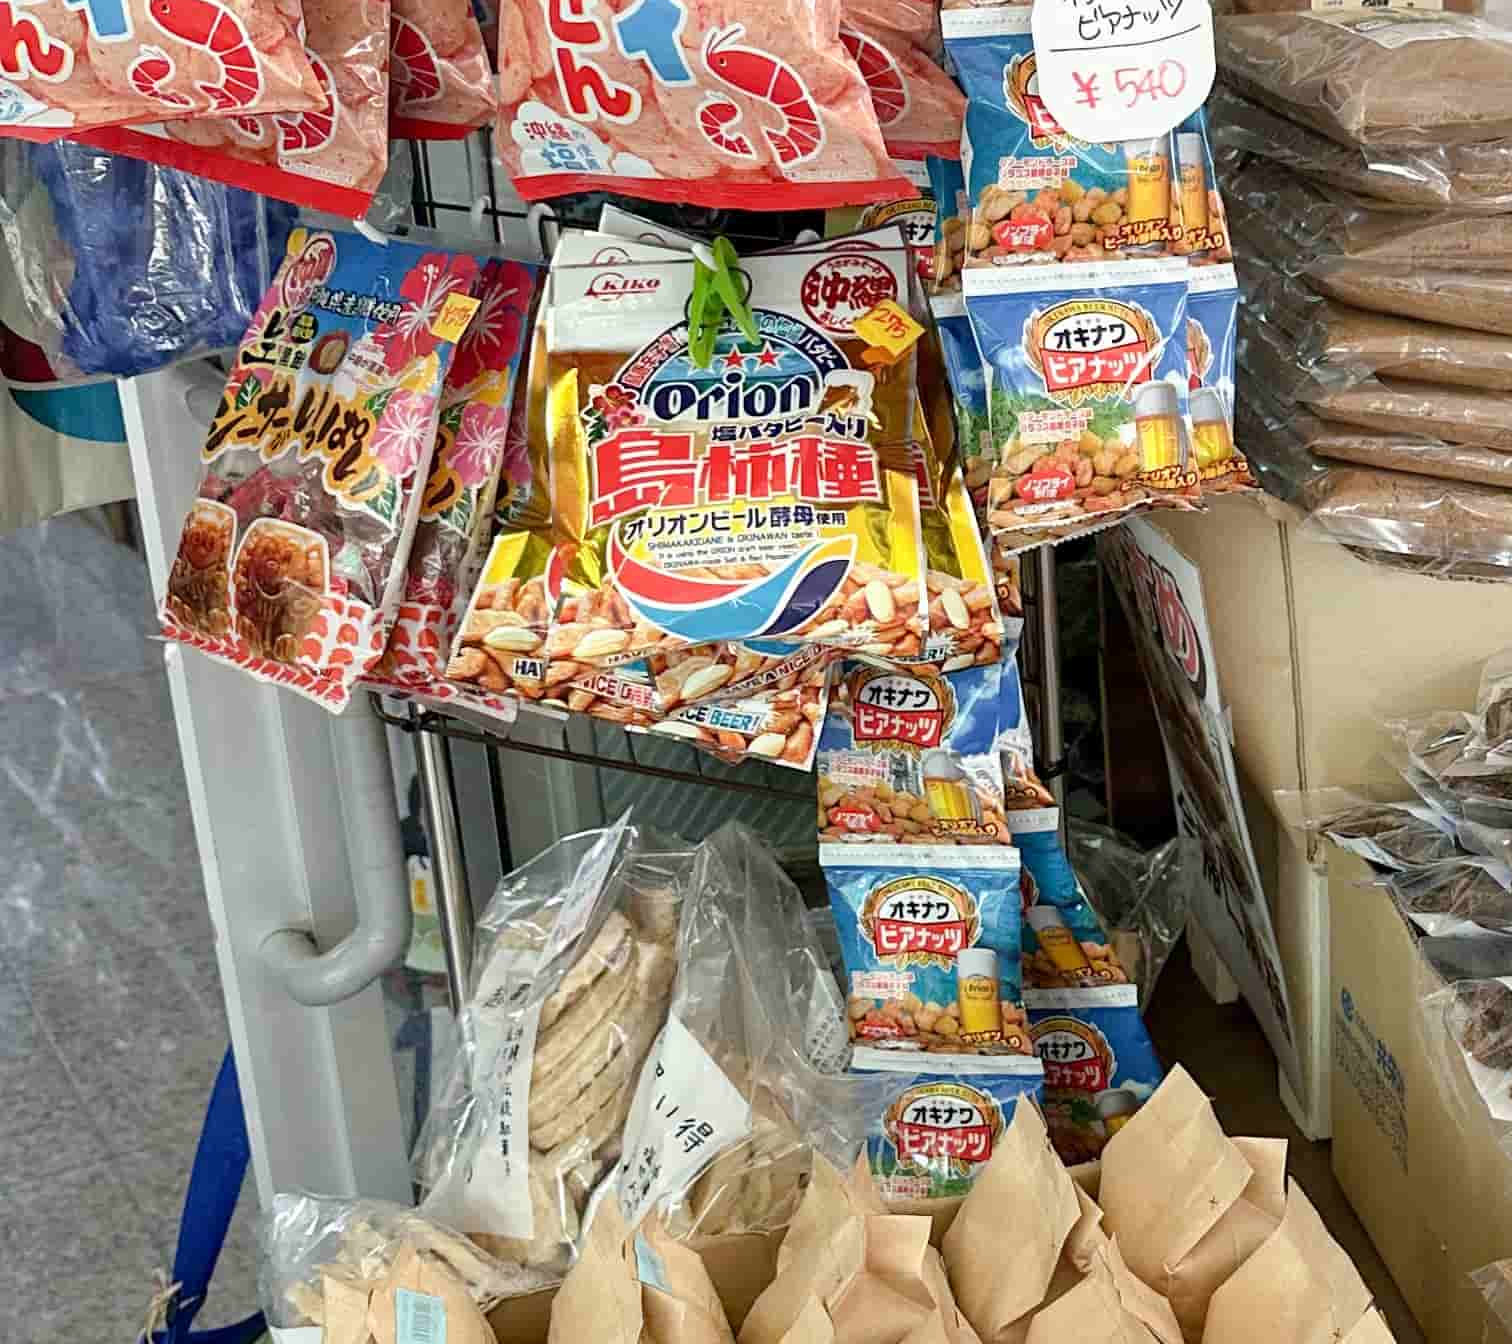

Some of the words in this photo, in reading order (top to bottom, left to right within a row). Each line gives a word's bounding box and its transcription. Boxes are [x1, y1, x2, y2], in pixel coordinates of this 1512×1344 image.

[1055, 325, 1126, 349] オキナワ
[867, 687, 930, 709] オキナワ
[888, 899, 949, 921] オキナワ
[911, 1103, 973, 1124] オキナワ
